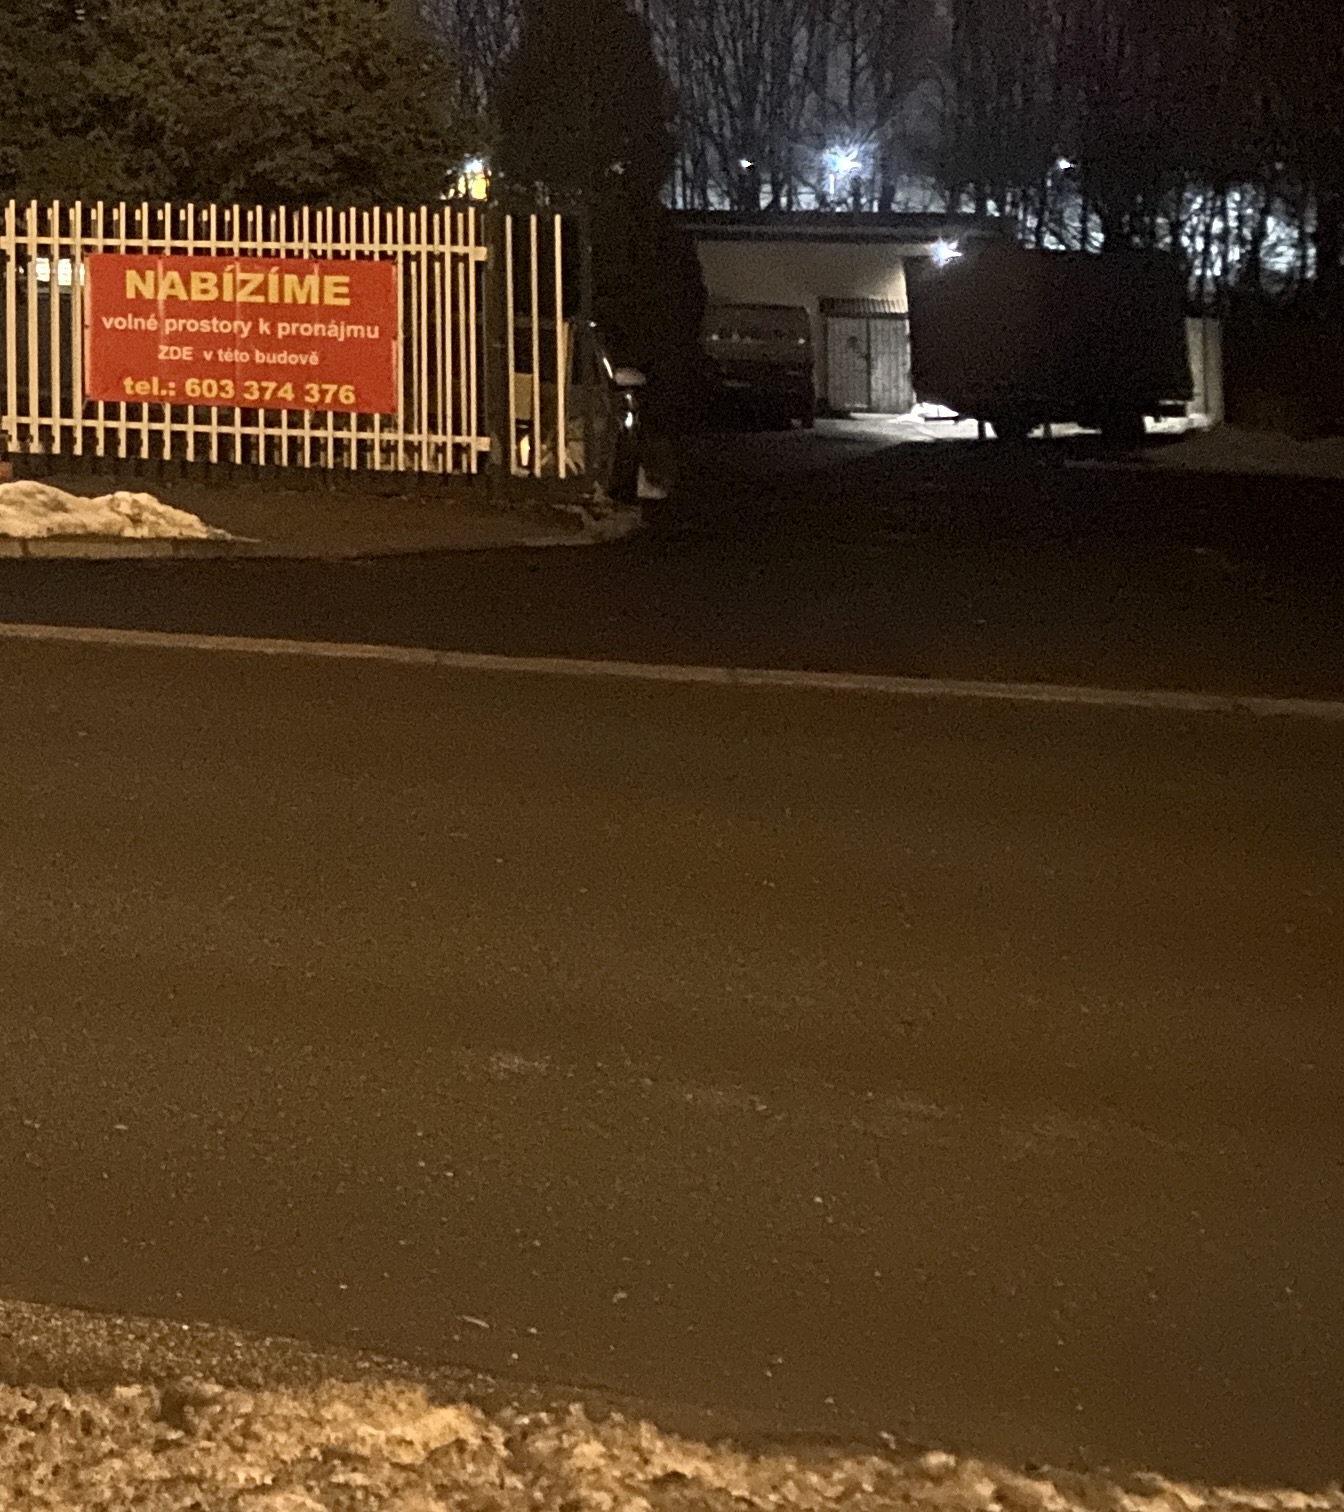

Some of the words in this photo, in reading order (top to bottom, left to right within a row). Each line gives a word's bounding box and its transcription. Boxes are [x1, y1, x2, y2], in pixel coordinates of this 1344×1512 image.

[125, 264, 351, 306] NABÍZÍME
[102, 314, 158, 332] volné
[164, 317, 253, 338] prostory
[259, 318, 271, 334] k
[277, 321, 380, 342] pronájmu
[158, 345, 194, 361] ZDE
[203, 349, 213, 361] v
[218, 348, 250, 363] této
[255, 349, 320, 365] budově
[123, 376, 177, 397] tel.:
[184, 378, 235, 399] 603
[243, 380, 295, 401] 374
[304, 383, 356, 404] 376
